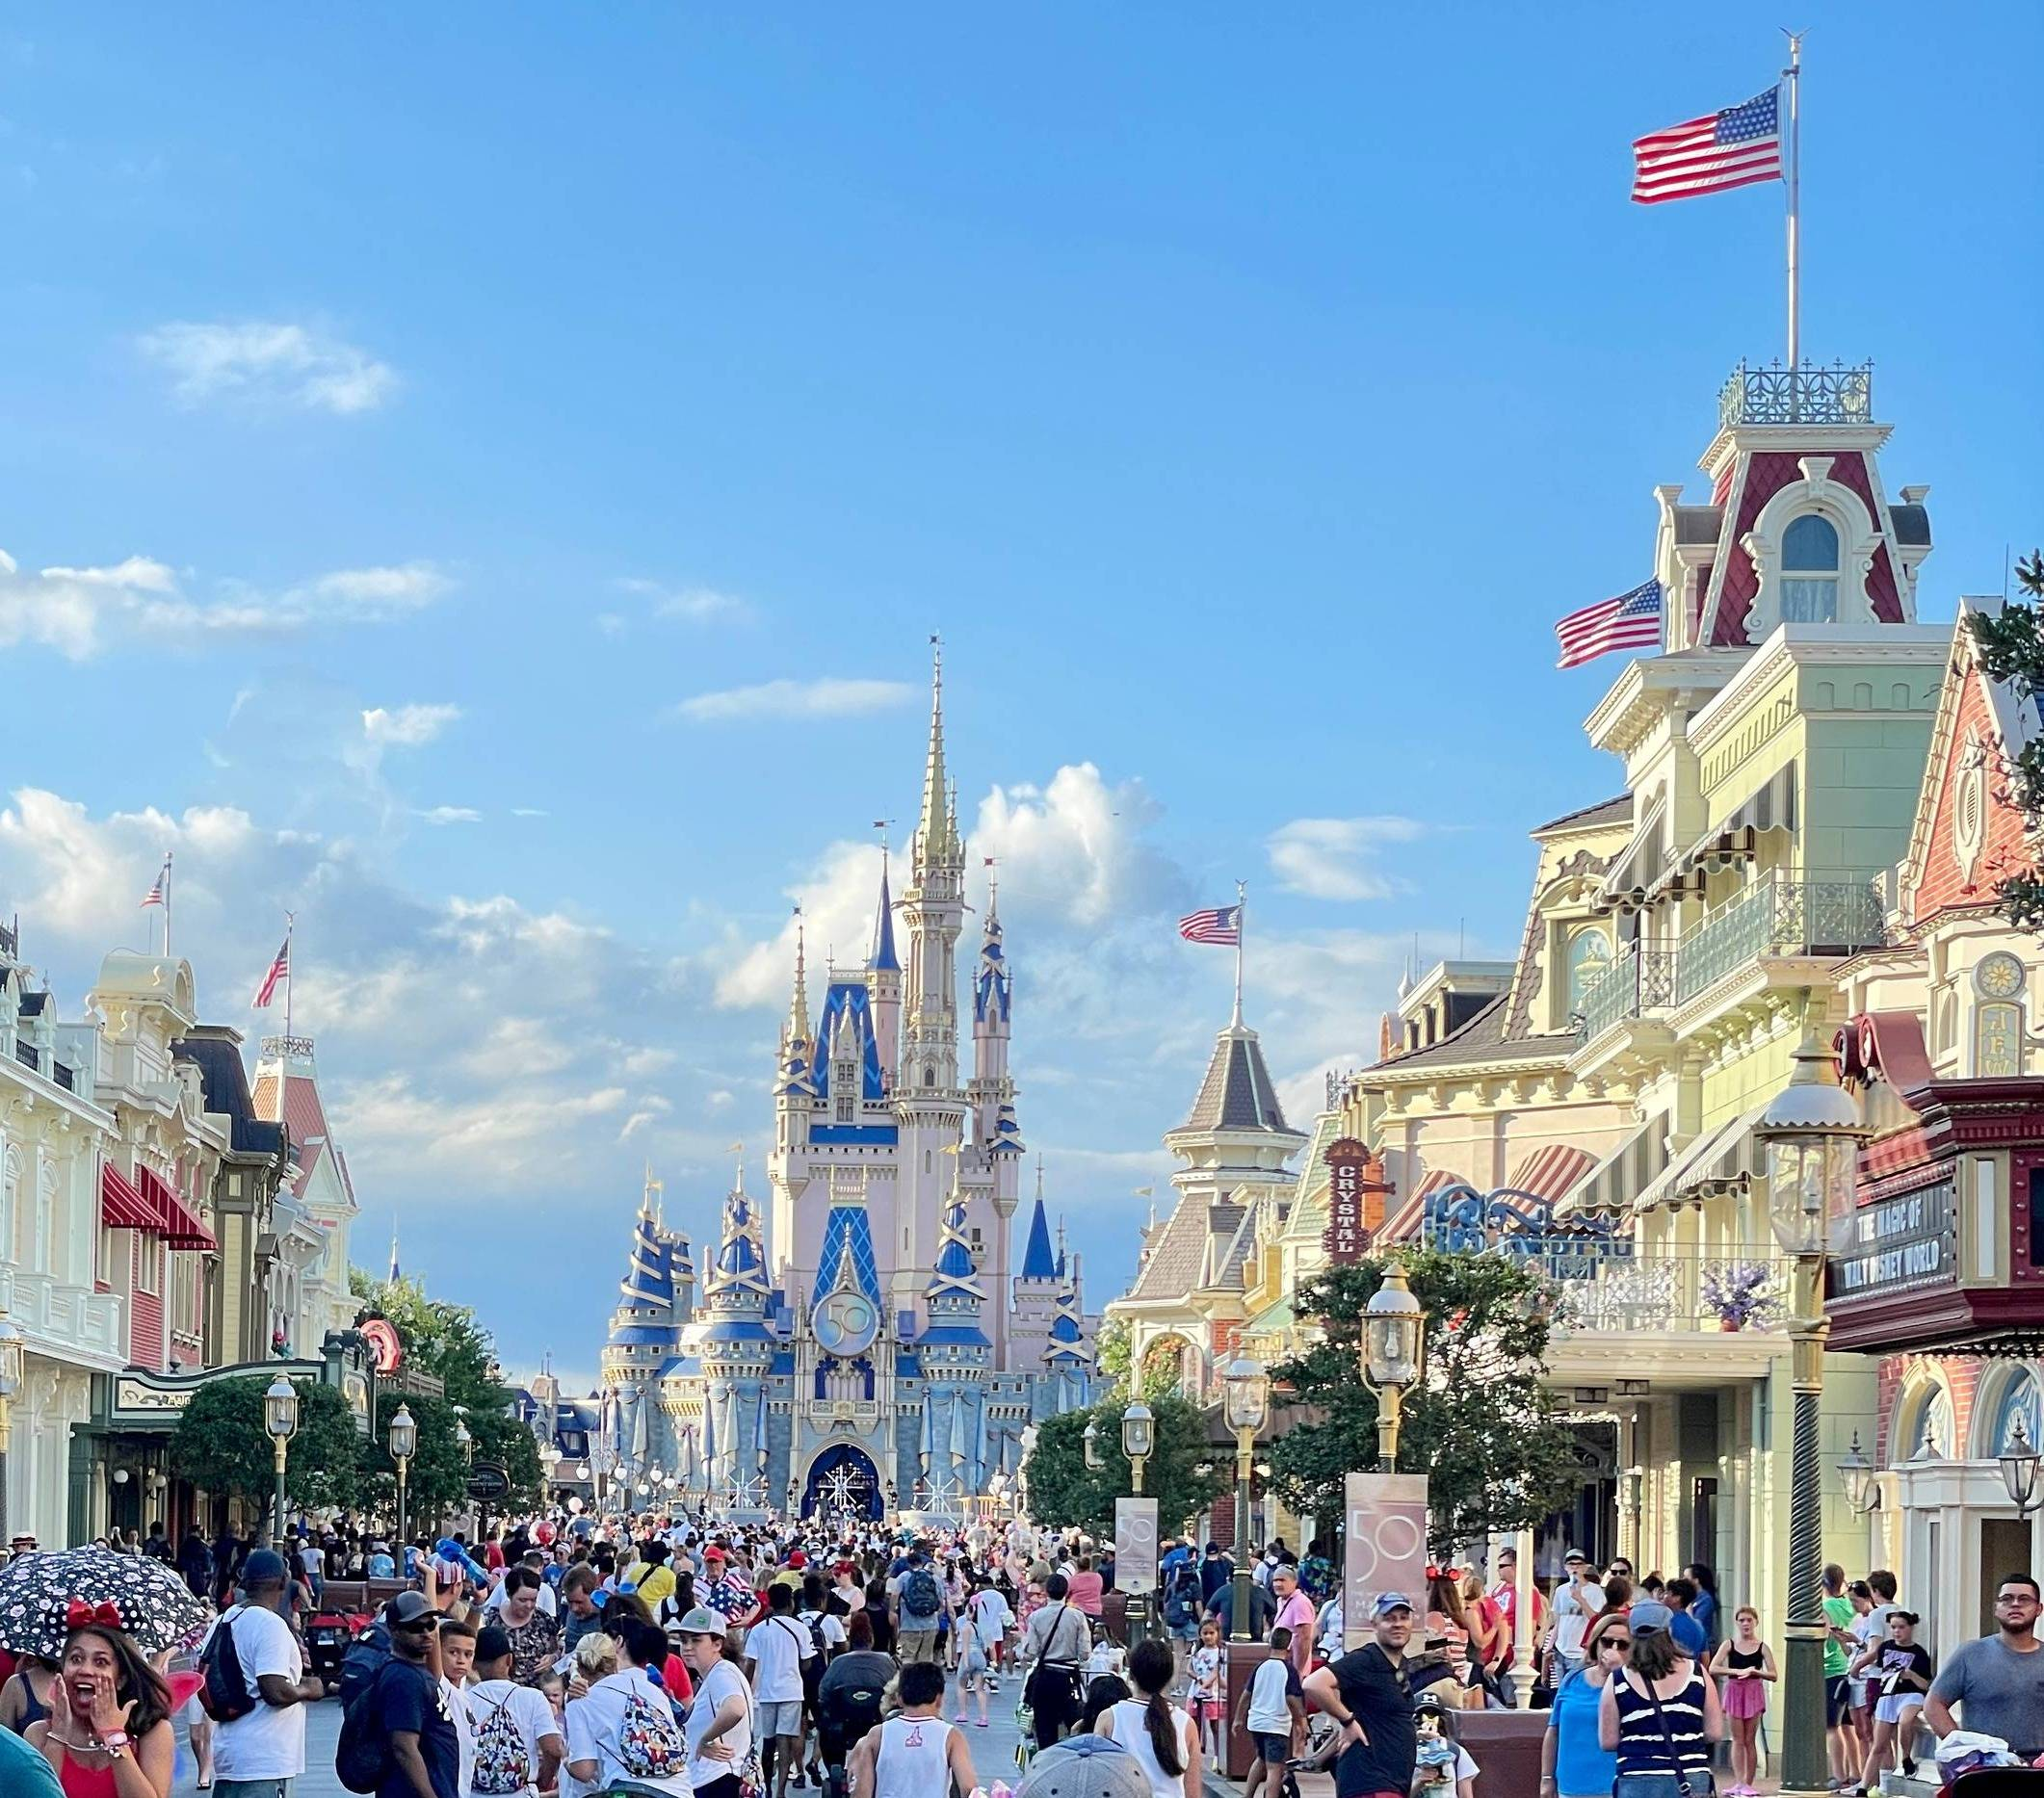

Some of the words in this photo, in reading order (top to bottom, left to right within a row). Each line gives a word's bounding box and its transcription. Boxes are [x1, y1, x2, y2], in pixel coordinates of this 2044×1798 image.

[1336, 1165, 1357, 1253] CRYSTAL
[1857, 1212, 1876, 1243] THE
[1876, 1202, 1907, 1238] MAGIC
[1908, 1197, 1923, 1230] OF
[1843, 1257, 1869, 1290] WALT
[1869, 1249, 1903, 1285] DISNEY
[1903, 1239, 1940, 1276] WORLD
[827, 1303, 870, 1349] 50
[1118, 1515, 1154, 1555] 50
[1351, 1508, 1420, 1584] 50
